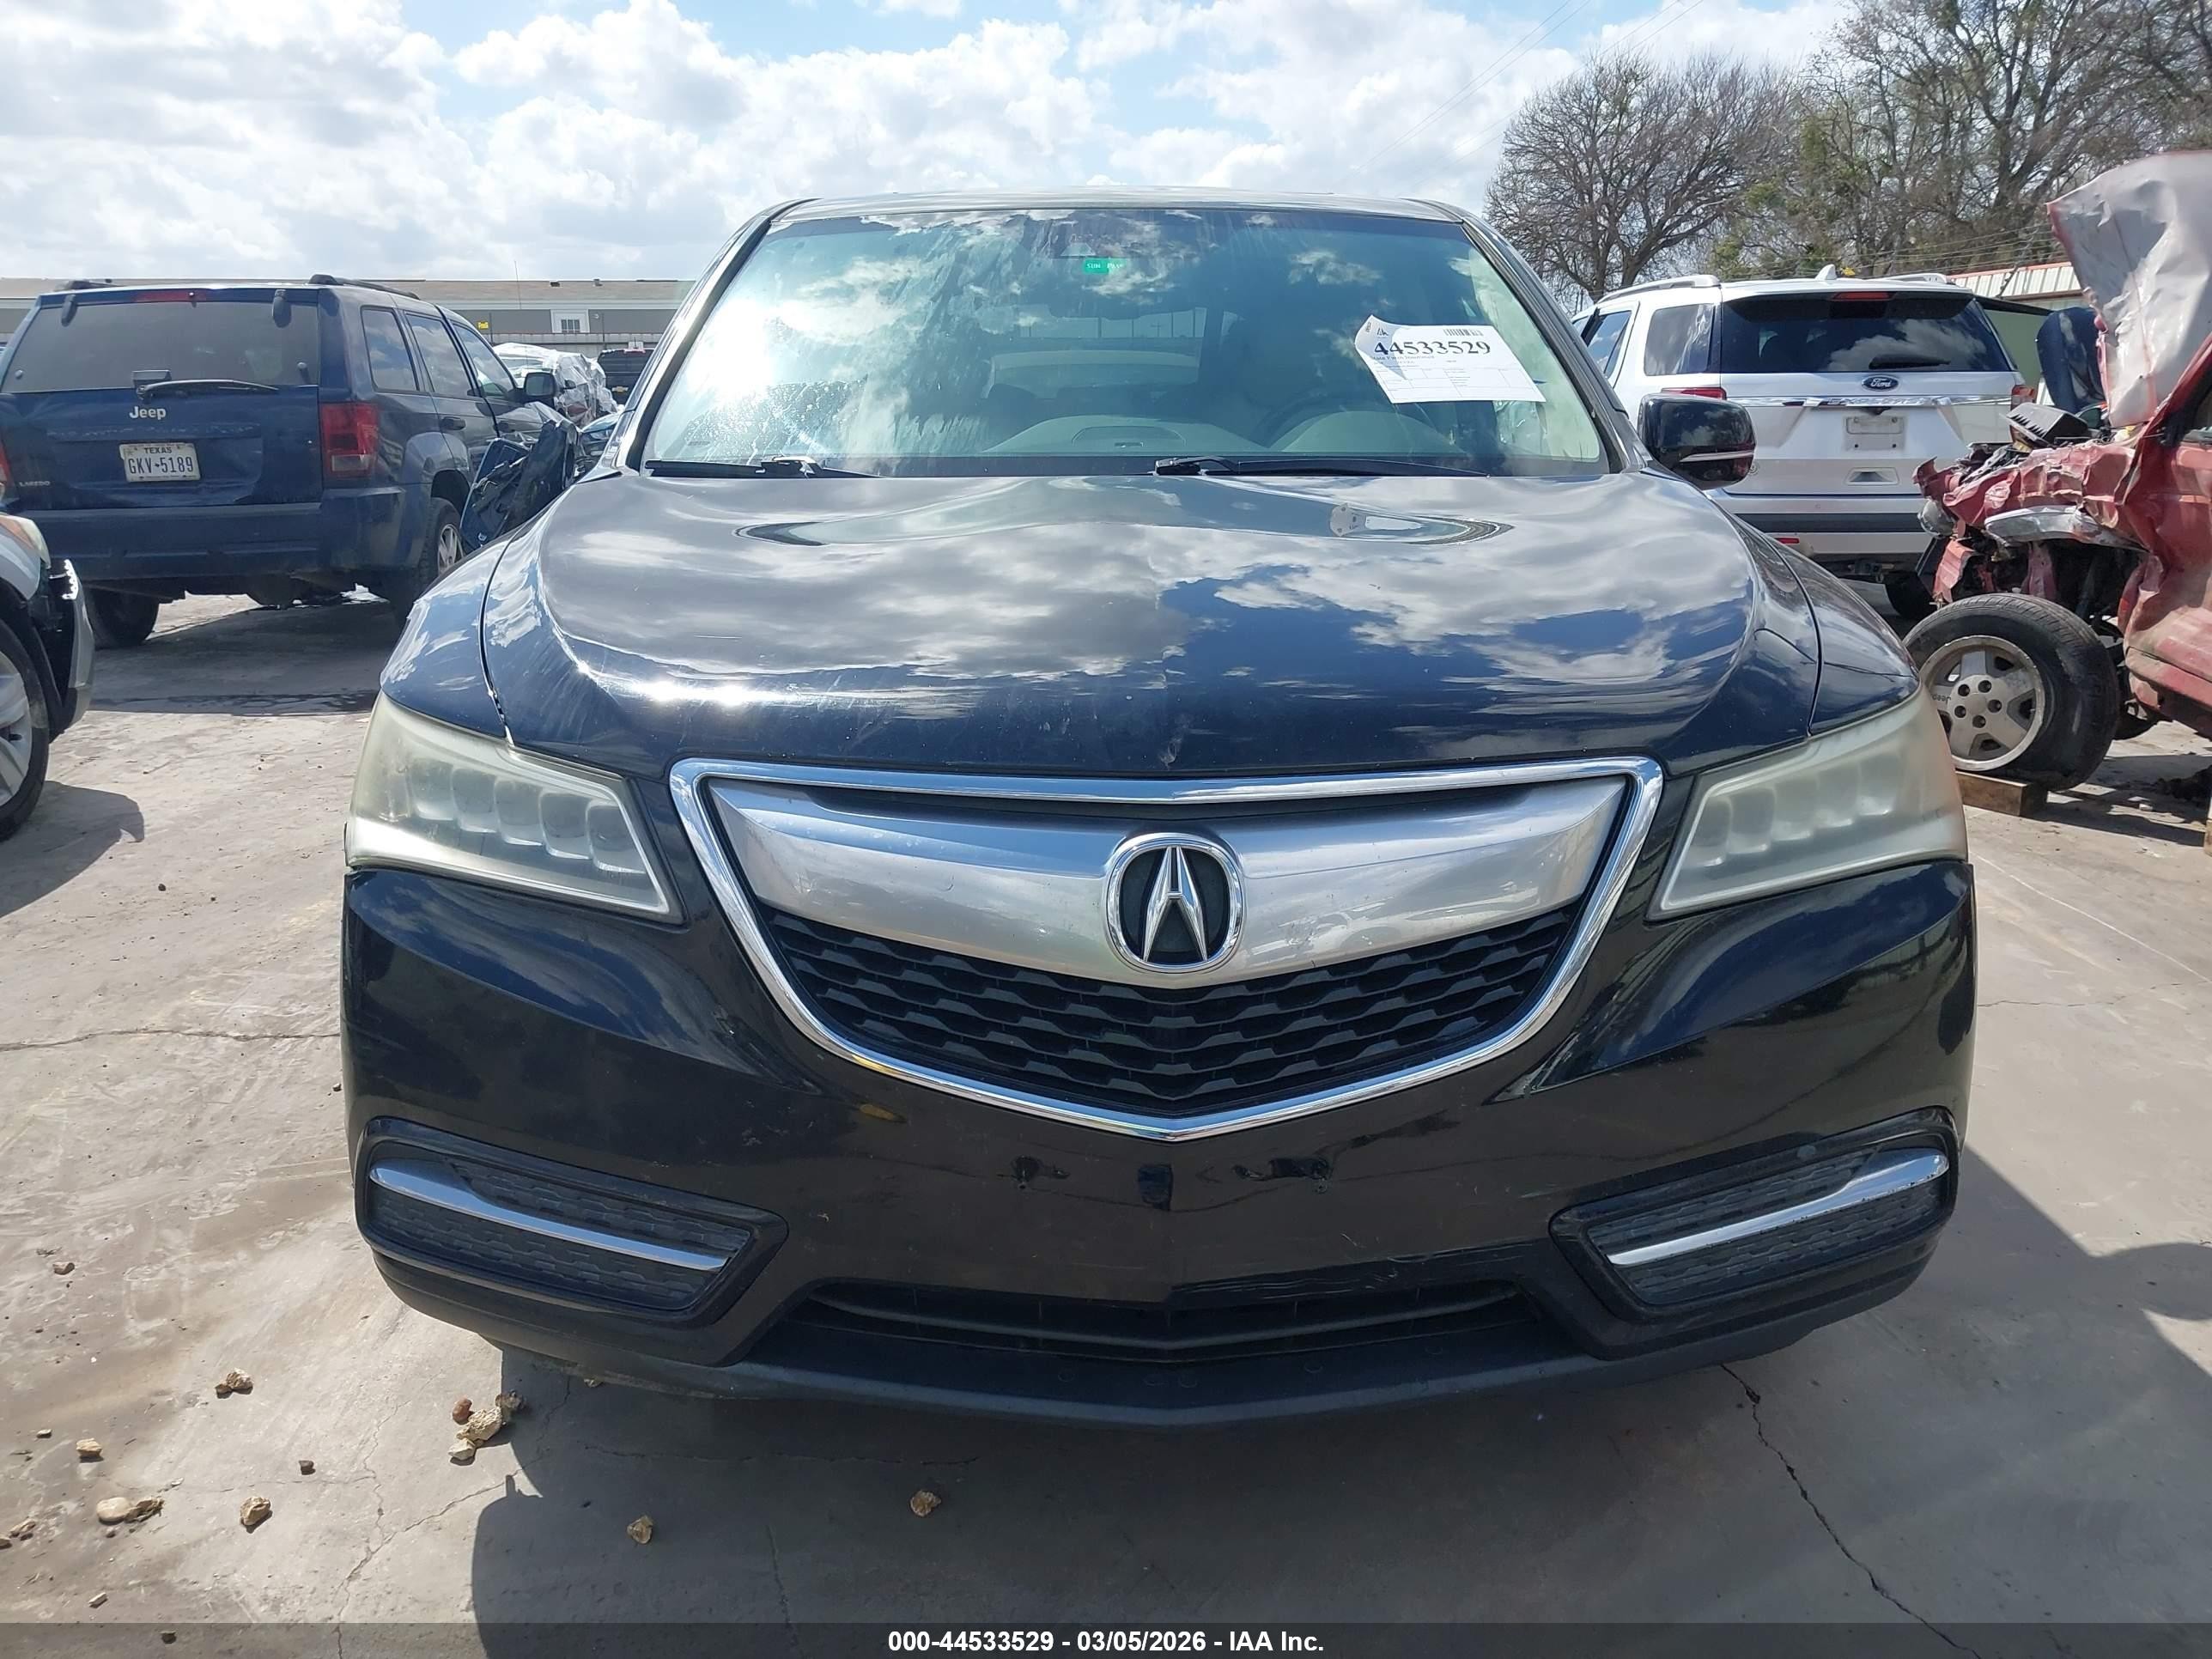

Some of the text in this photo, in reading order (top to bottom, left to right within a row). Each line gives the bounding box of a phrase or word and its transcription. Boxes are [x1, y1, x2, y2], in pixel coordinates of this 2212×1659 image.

[1374, 341, 1491, 355] 44533529
[1870, 377, 1892, 388] Ford
[129, 405, 167, 420] Jeep
